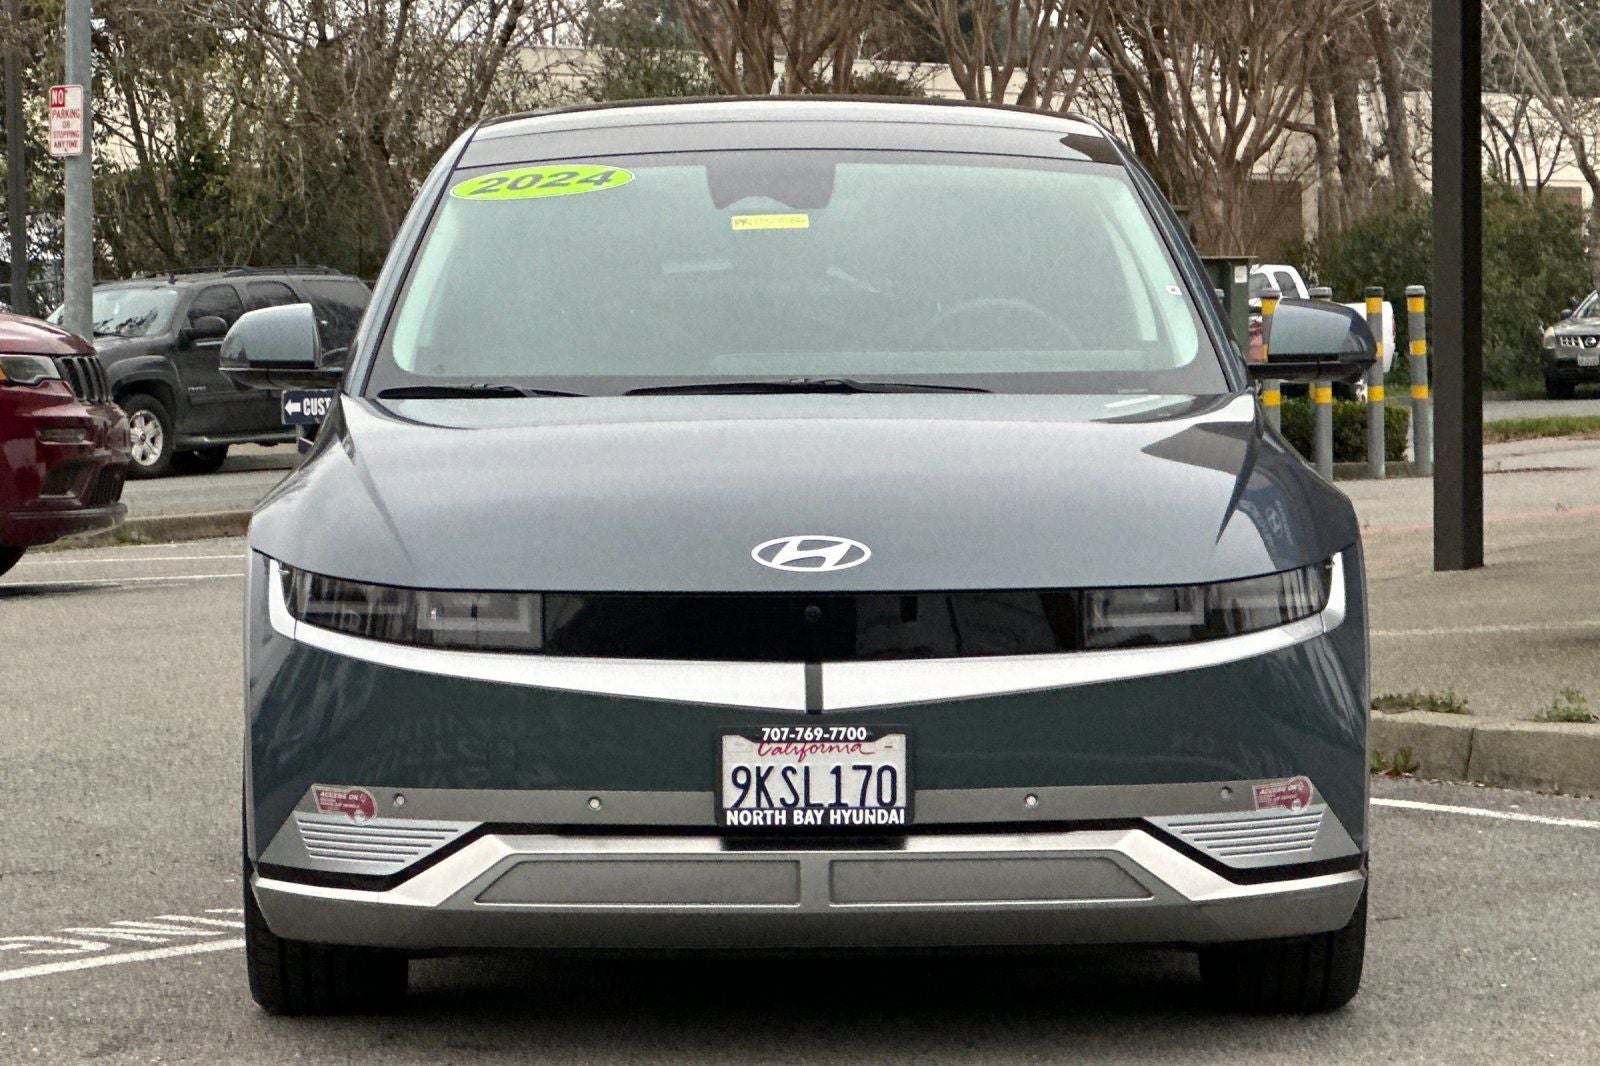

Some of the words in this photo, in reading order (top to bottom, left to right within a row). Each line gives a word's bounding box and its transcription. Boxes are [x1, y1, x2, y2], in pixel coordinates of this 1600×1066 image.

[51, 89, 64, 105] NO
[52, 109, 80, 118] PARKING
[53, 131, 80, 139] STOPPING
[66, 140, 78, 148] TIME
[467, 169, 617, 196] 2024
[761, 727, 867, 741] 707-769-7700
[757, 741, 875, 763] California
[731, 765, 897, 808] 9KSL170
[726, 810, 786, 826] NORTH
[793, 810, 825, 825] BAY
[829, 808, 905, 824] HYUNDAI
